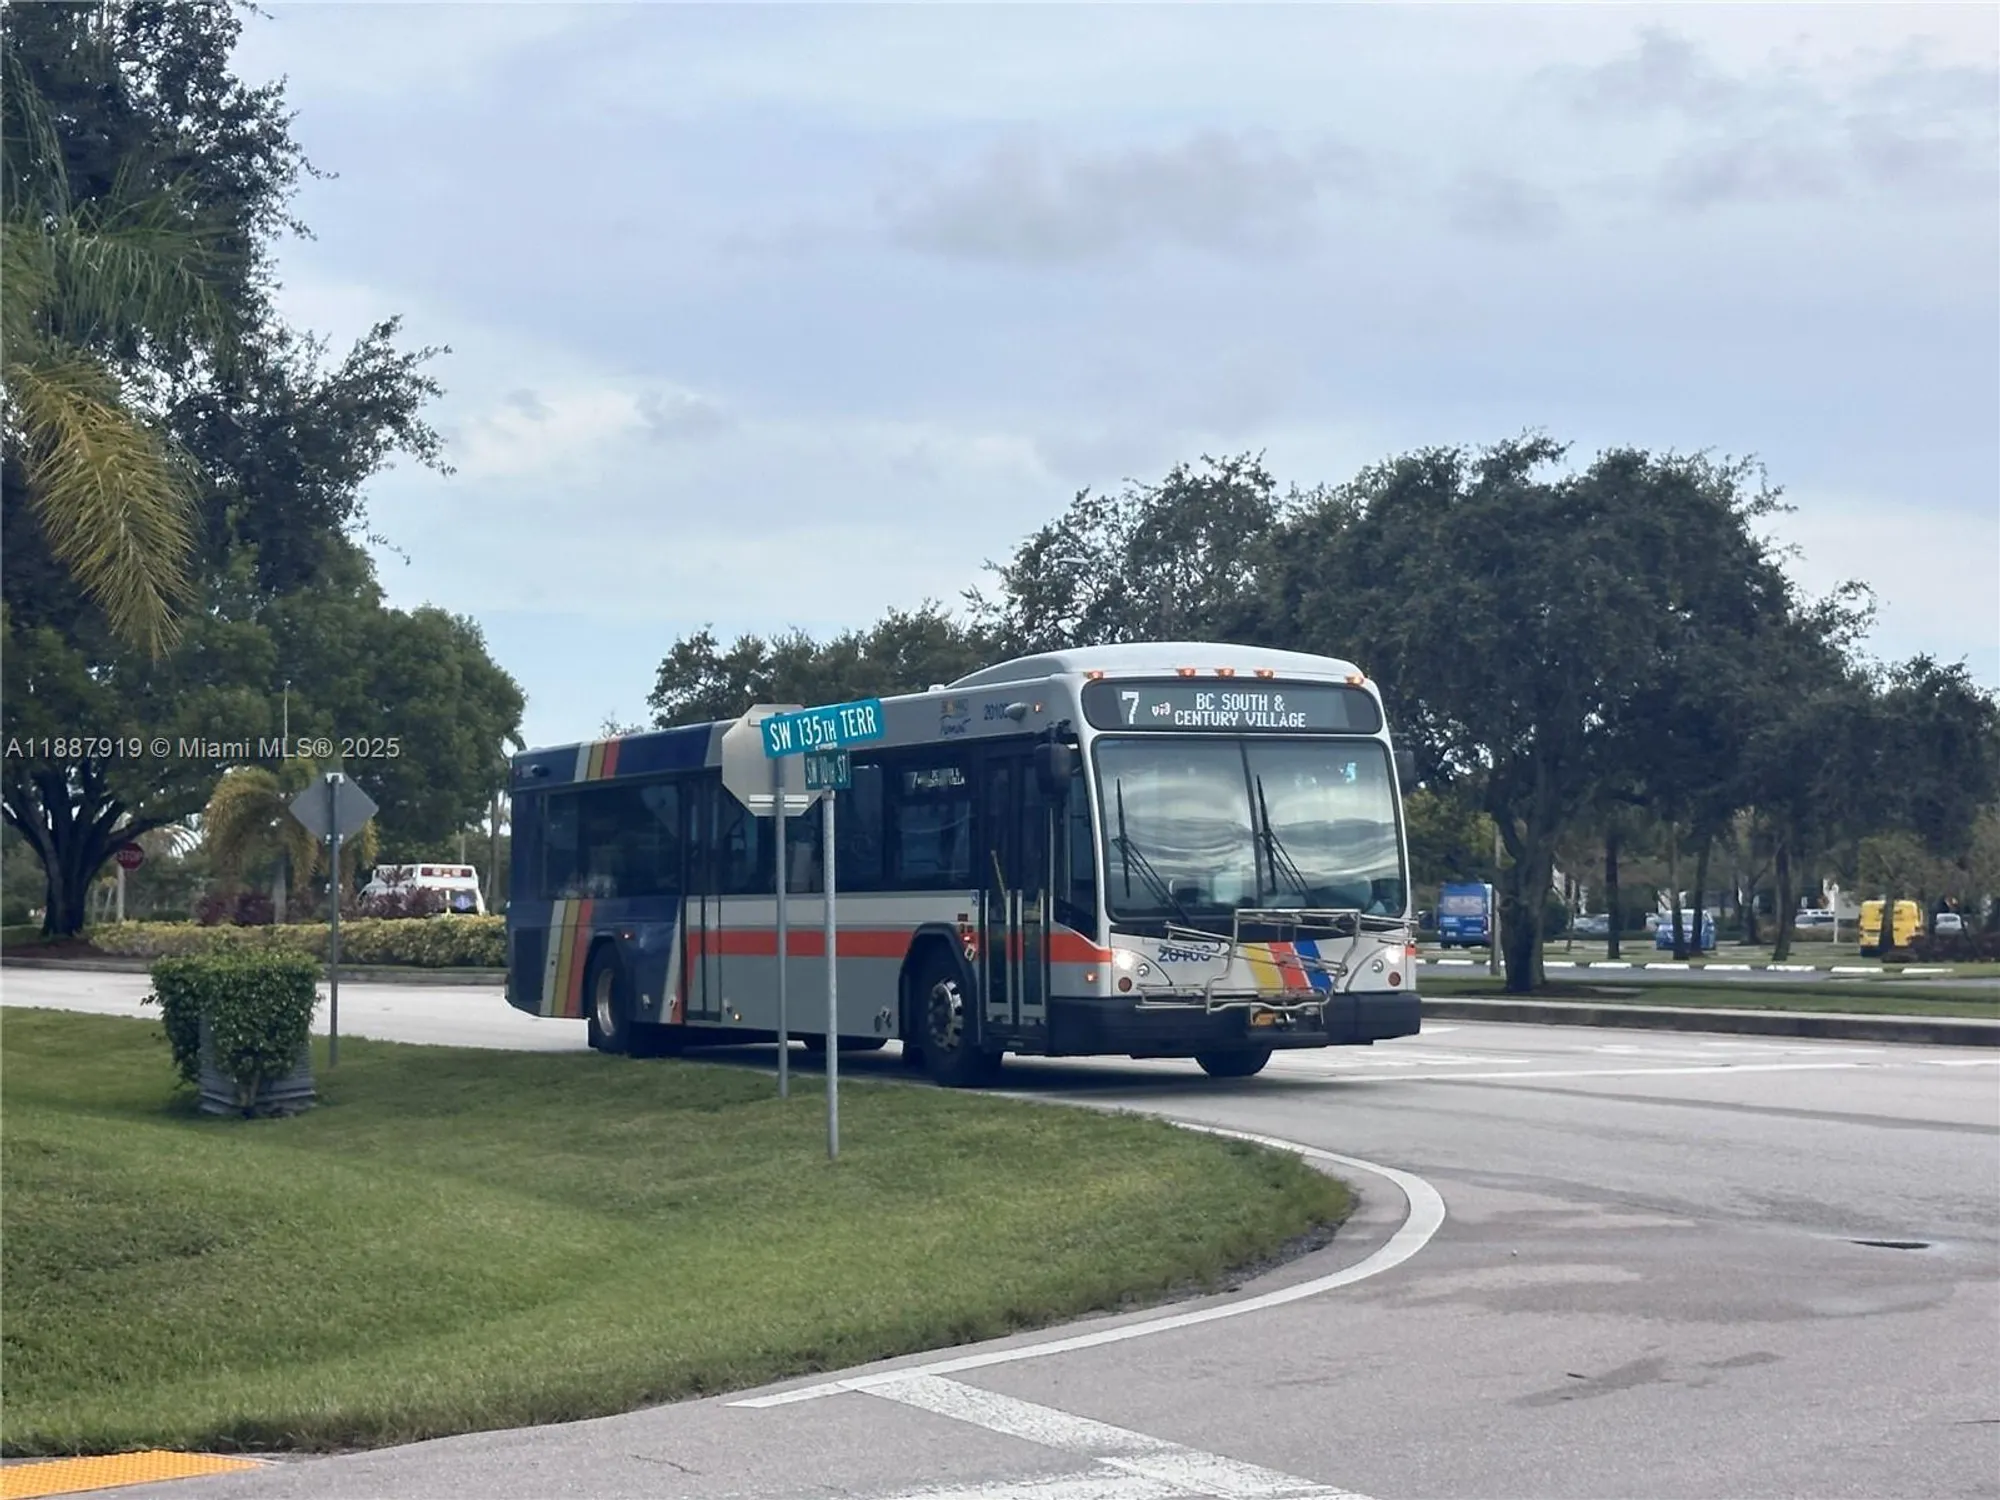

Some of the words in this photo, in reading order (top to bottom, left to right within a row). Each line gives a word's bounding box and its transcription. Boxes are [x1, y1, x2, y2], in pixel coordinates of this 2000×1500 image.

[1121, 691, 1140, 725] 7
[1196, 692, 1215, 711] BC
[1221, 693, 1268, 711] SOUTH
[1274, 694, 1285, 712] &
[770, 721, 791, 752] SW
[796, 715, 837, 746] 135TH
[839, 705, 877, 739] TERR
[1174, 710, 1238, 727] CENTURY
[1245, 711, 1307, 728] VILLAGE
